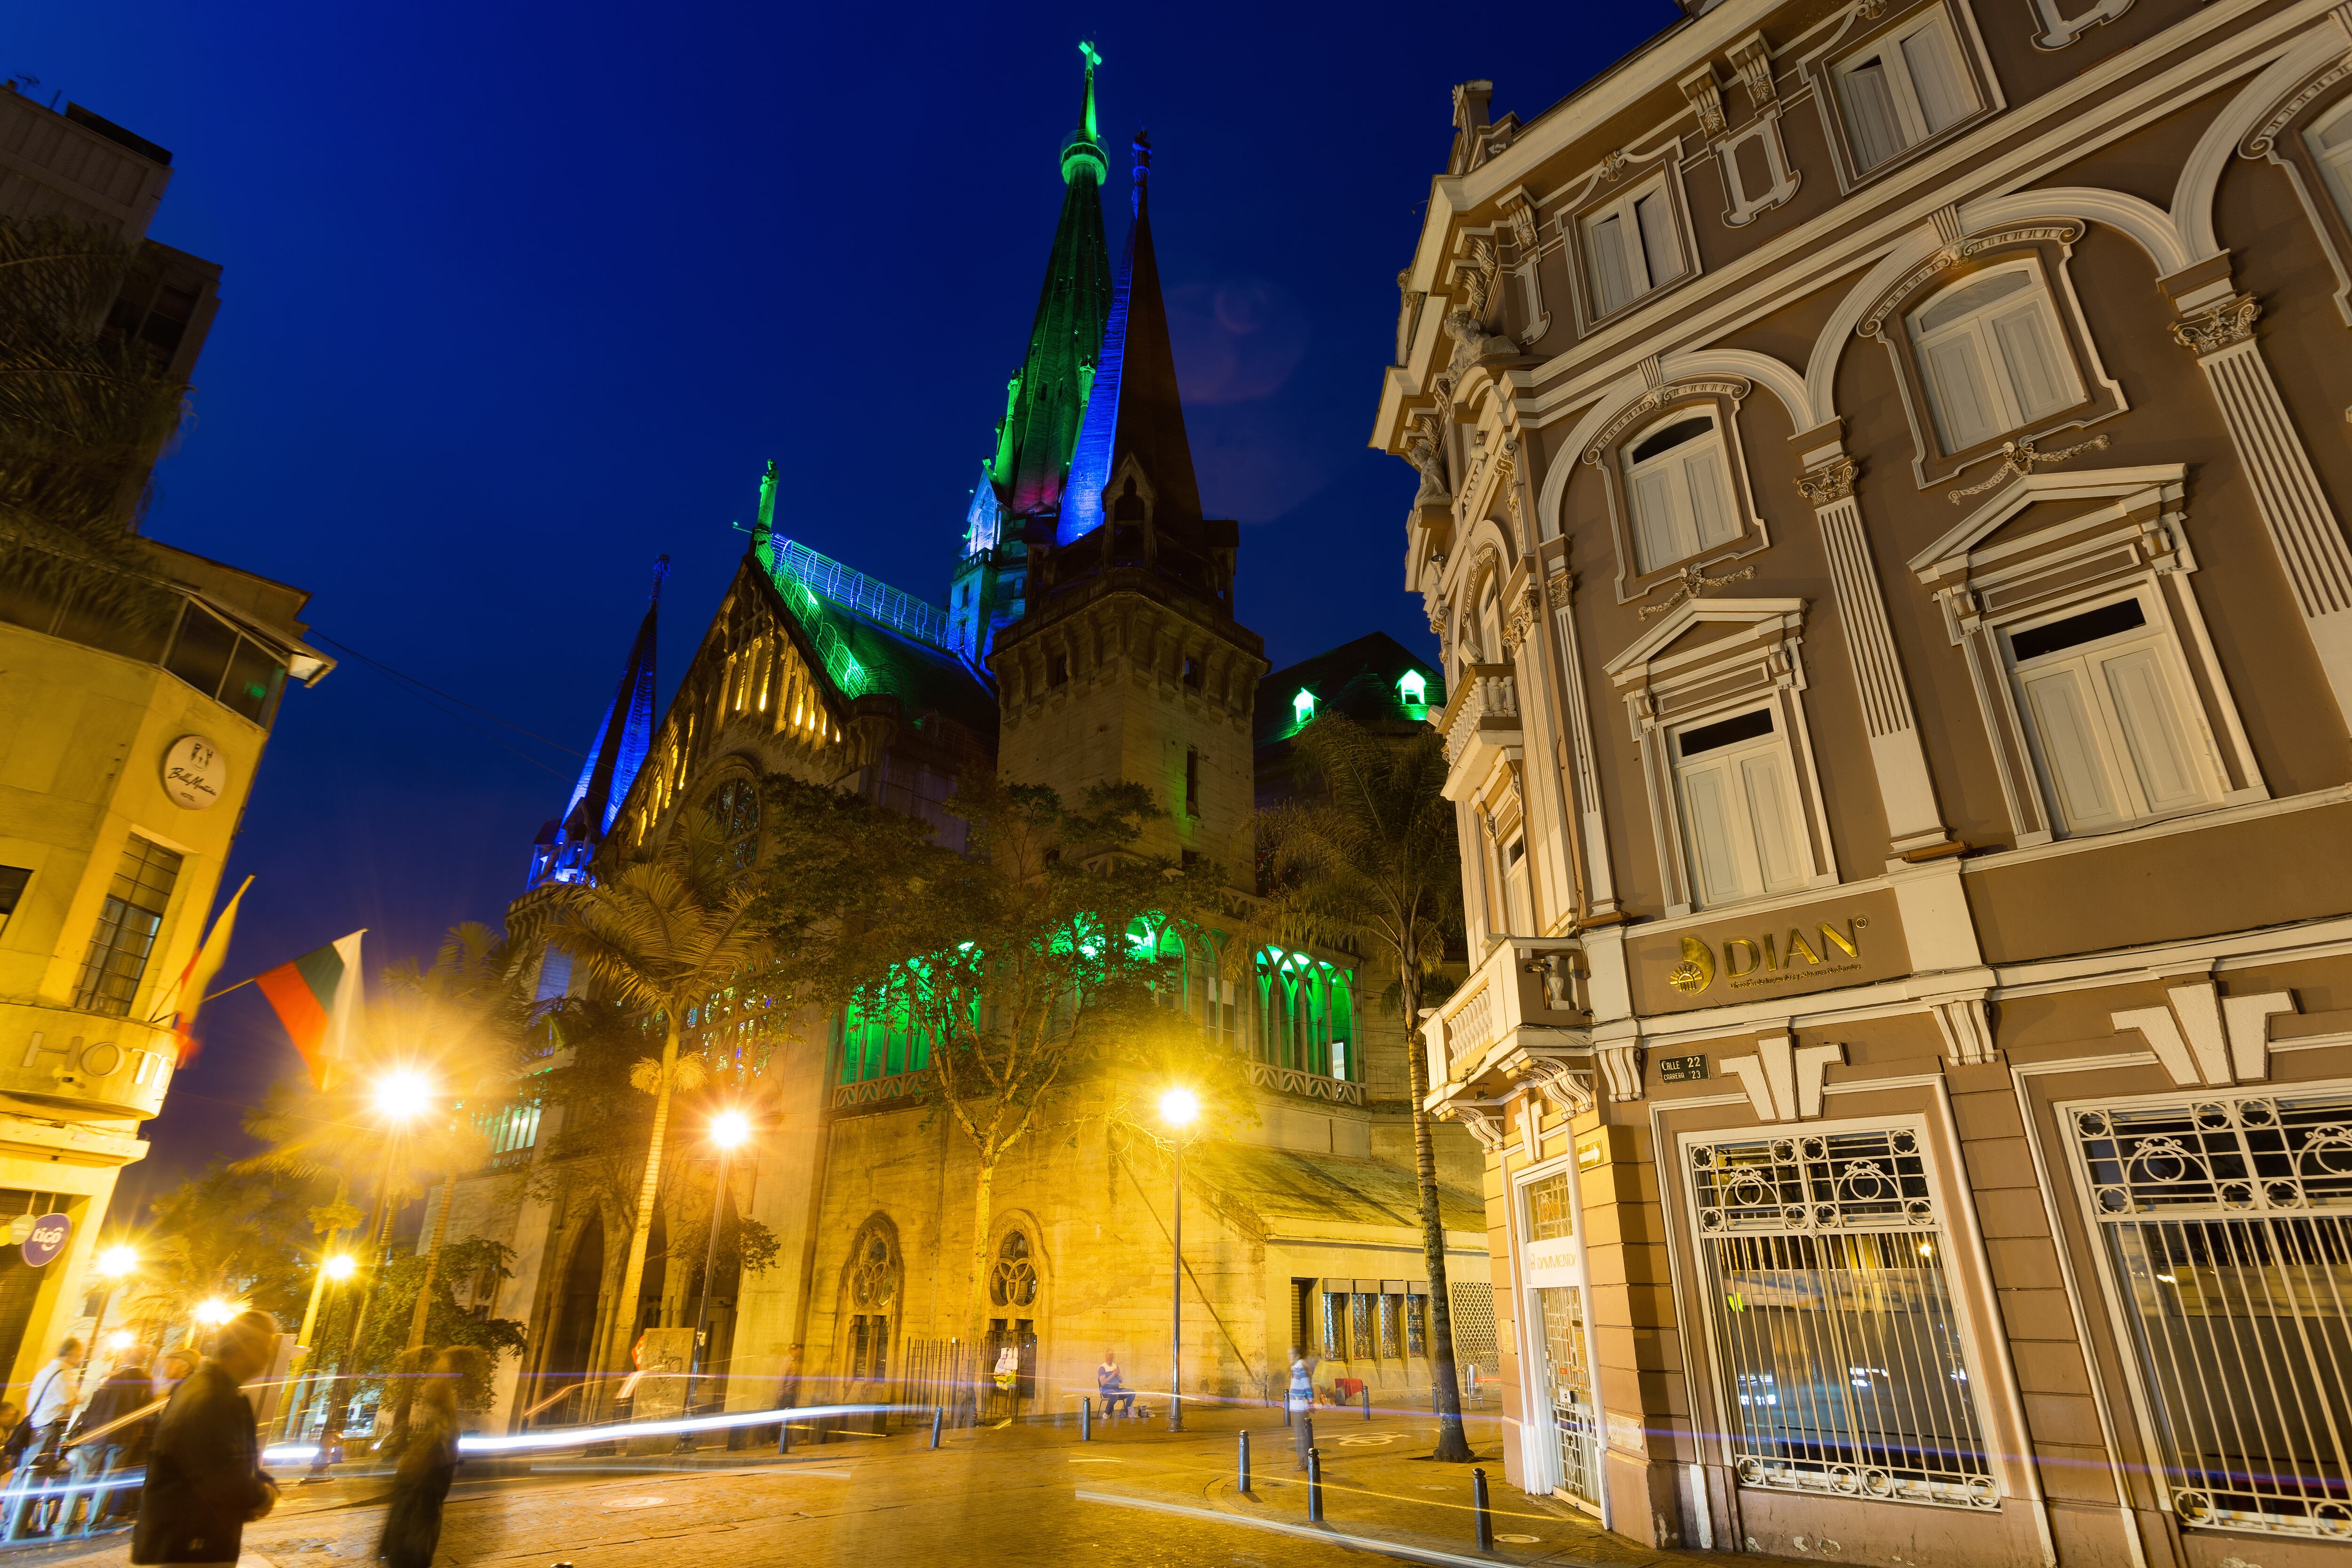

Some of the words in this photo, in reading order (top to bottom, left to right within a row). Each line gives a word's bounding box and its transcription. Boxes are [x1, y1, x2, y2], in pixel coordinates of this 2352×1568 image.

[1723, 918, 1859, 978] DIAN
[1731, 979, 1756, 990] Dirección
[1766, 974, 1795, 984] Impuestos
[1800, 970, 1827, 979] Aduanas
[1827, 963, 1861, 974] Nacionales
[1661, 1060, 1681, 1071] CALLE
[1687, 1056, 1701, 1068] 22
[1663, 1072, 1685, 1081] CARRERA
[1691, 1070, 1701, 1079] 23
